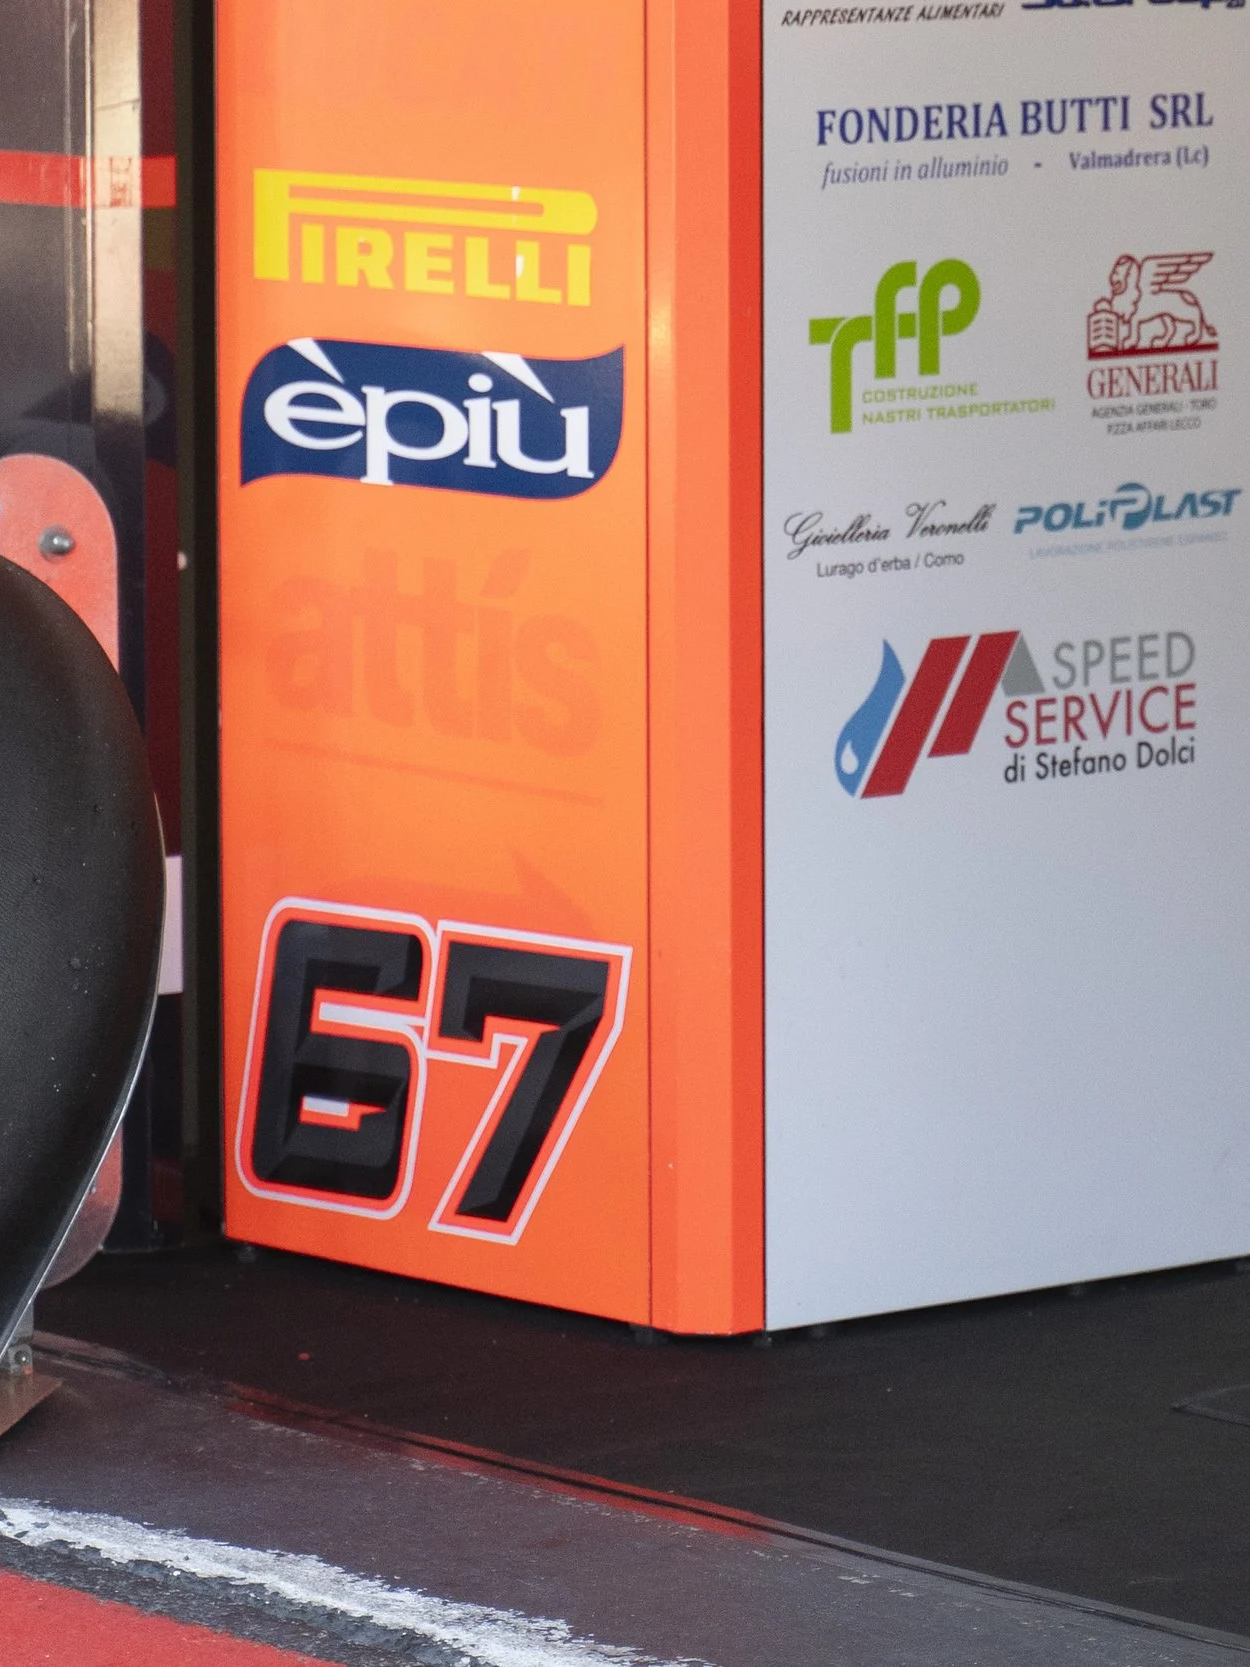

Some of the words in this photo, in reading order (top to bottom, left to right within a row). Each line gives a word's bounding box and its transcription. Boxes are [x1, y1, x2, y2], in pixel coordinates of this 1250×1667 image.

[781, 4, 913, 27] RAPPRESENTANZE
[916, 2, 1006, 21] ALIMENTARI
[816, 101, 1010, 147] FONDERIA
[1020, 94, 1132, 137] BUTTI
[1149, 91, 1215, 130] SRL
[821, 158, 890, 191] fusioni
[893, 160, 912, 183] in
[916, 154, 1010, 182] alluminio
[1069, 148, 1172, 172] Valmadrera
[1175, 145, 1210, 169] (Lc)
[253, 167, 599, 308] PIRELLI
[862, 382, 979, 404] COSTRUZIONE
[1086, 359, 1219, 400] GENERALI
[862, 407, 922, 425] NASTRI
[927, 397, 1056, 421] TRASPORTATORI
[783, 510, 891, 560] Gioielleria
[905, 500, 997, 540] Veronelli
[816, 561, 865, 580] Lurago
[922, 551, 966, 569] Como
[1052, 630, 1197, 690] SPEED
[1003, 682, 1197, 749] SERVICE
[1004, 749, 1026, 783] di
[1035, 743, 1128, 780] Stefano
[1136, 736, 1197, 769] Dolci
[235, 896, 633, 1246] 67
